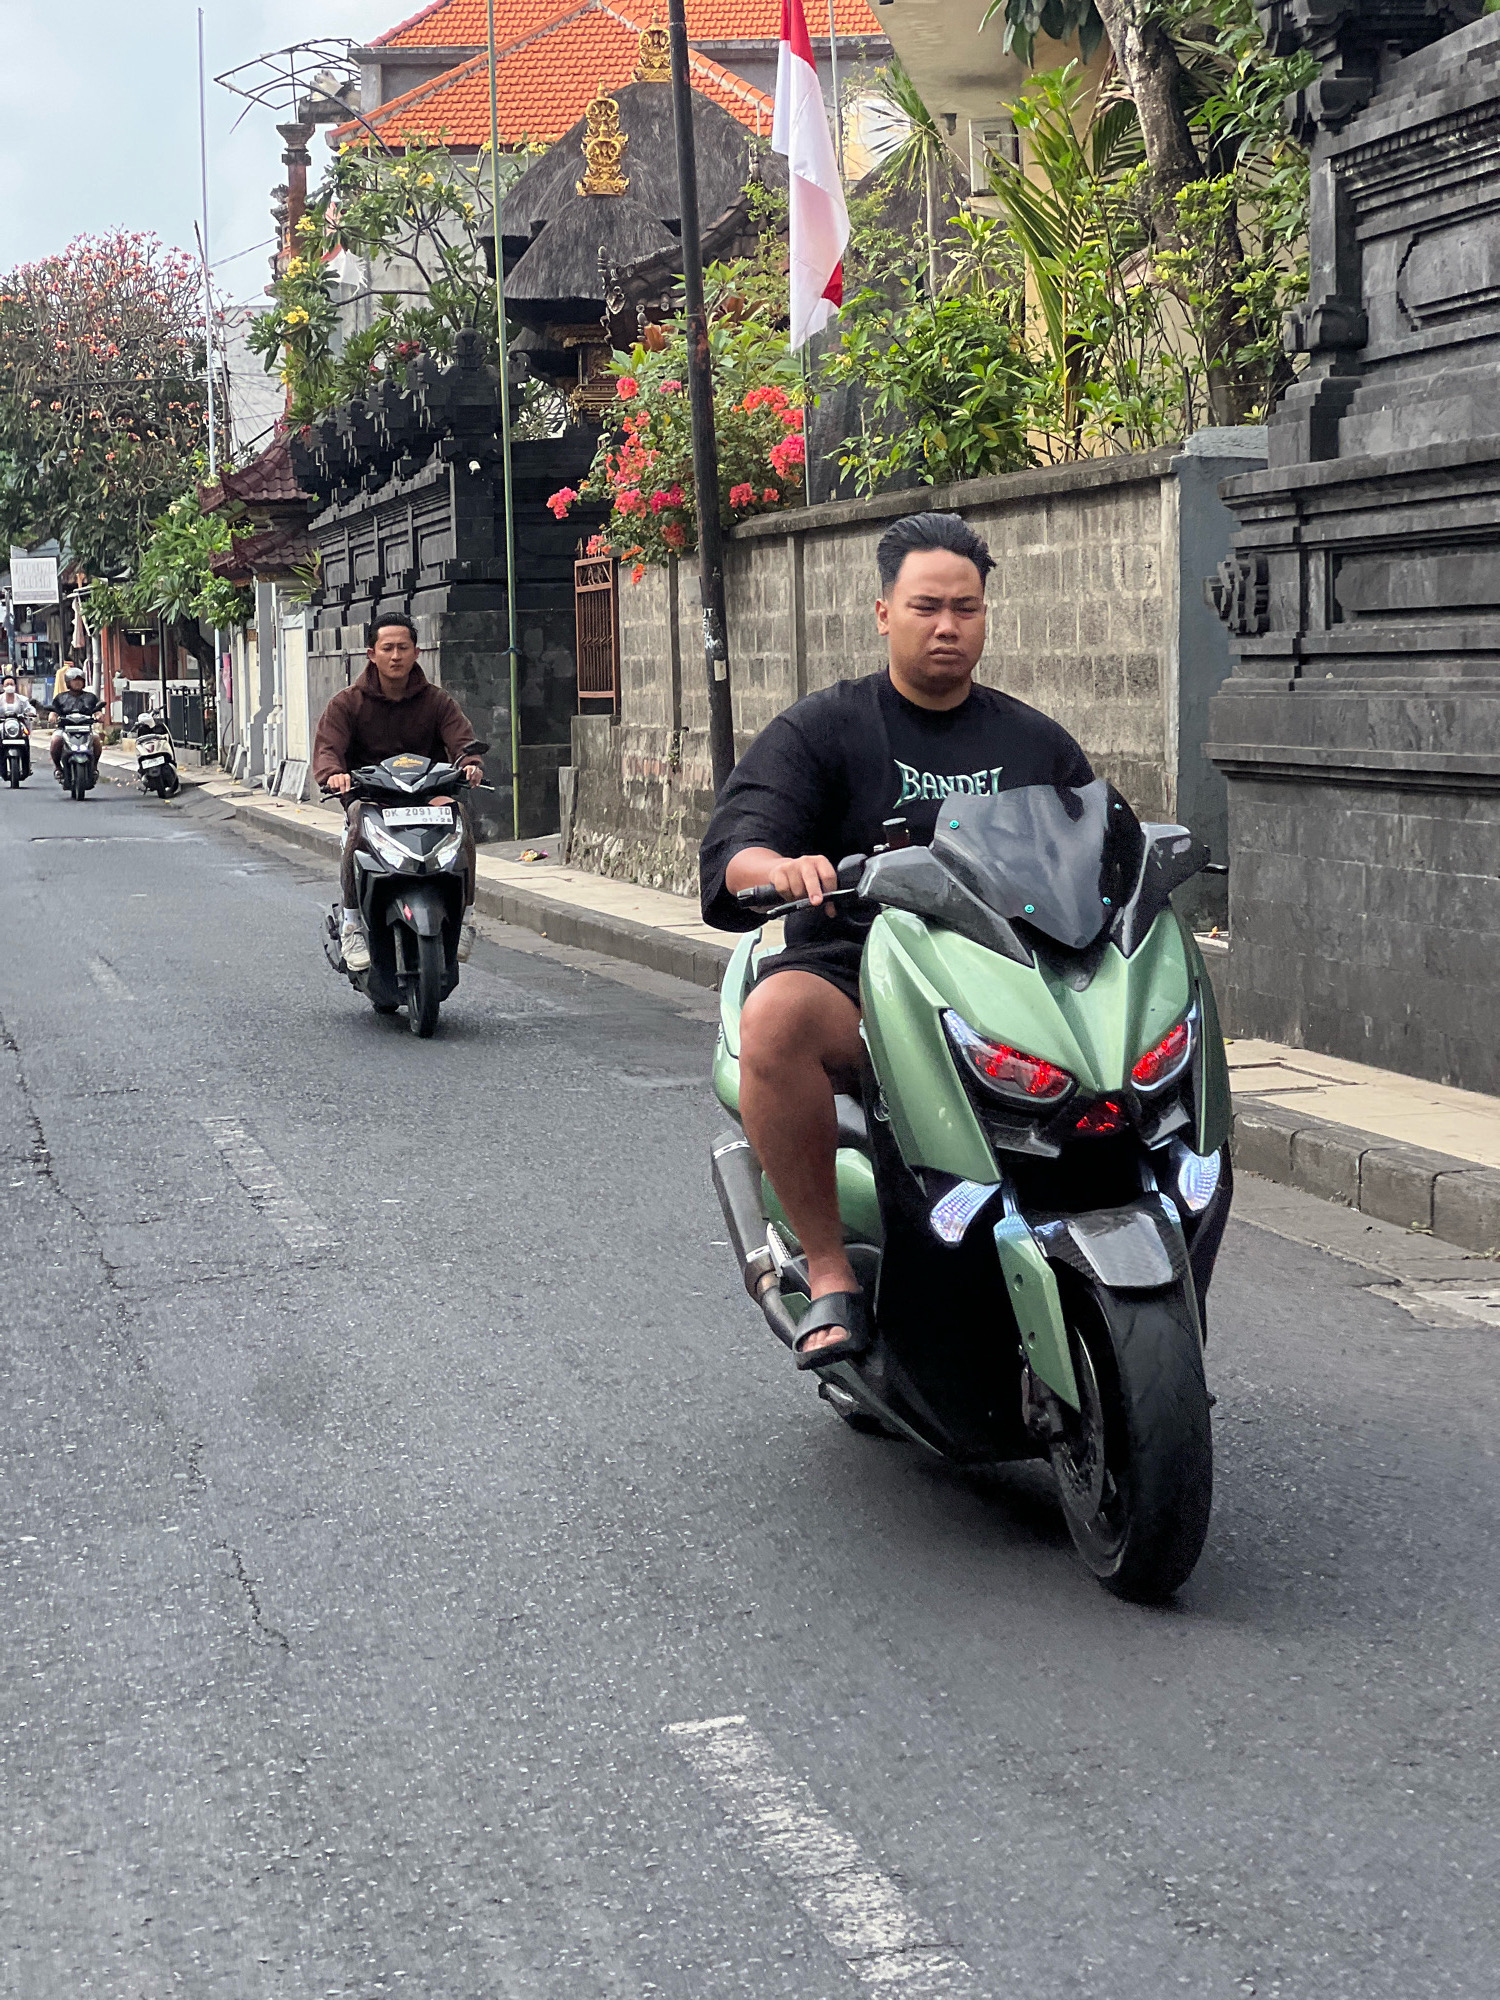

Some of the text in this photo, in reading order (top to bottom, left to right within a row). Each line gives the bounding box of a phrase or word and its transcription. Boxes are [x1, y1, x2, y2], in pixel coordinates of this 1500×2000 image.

[384, 806, 451, 818] DK 2091 TD
